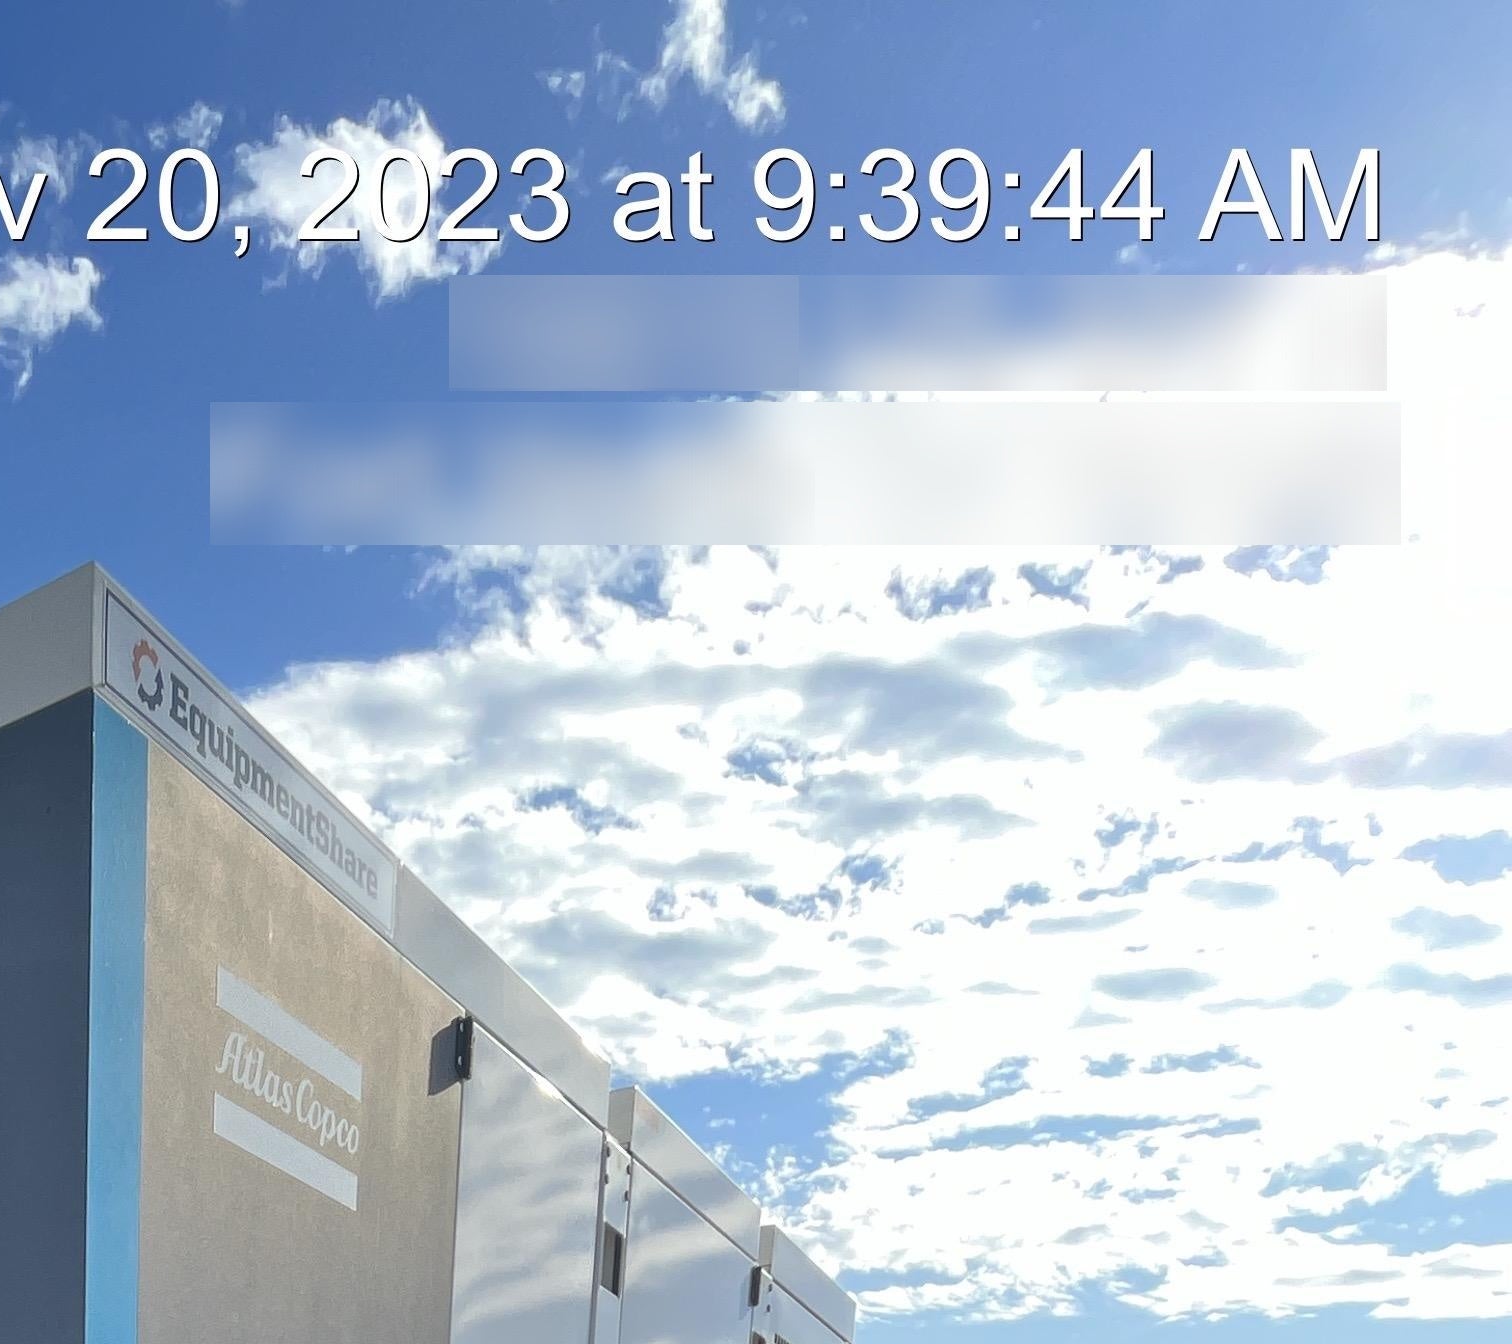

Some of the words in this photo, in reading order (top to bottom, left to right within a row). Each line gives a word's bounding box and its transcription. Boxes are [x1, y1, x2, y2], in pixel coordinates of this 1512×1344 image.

[169, 672, 378, 900] EquipmentShare
[215, 1031, 293, 1114] Atlas
[295, 1078, 359, 1155] Copco
